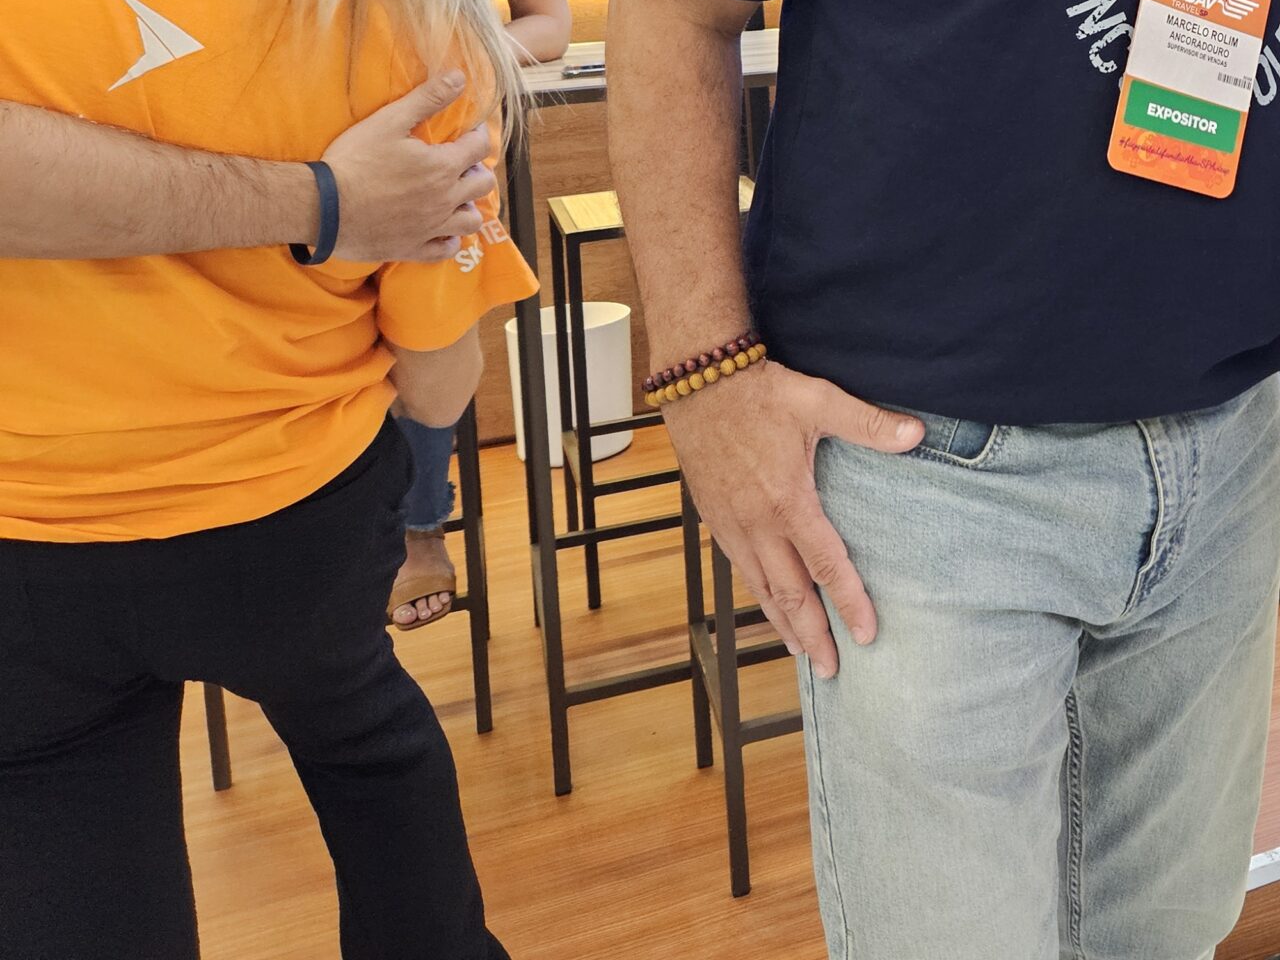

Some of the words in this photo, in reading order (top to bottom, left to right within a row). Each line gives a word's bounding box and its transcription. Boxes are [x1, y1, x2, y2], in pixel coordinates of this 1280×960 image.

[1166, 14, 1209, 37] MARCELO
[1210, 29, 1239, 47] ROLIM
[1169, 31, 1230, 58] ANCORADOURO
[1167, 42, 1199, 58] SUPERVISOR
[1207, 54, 1228, 68] VENDAS
[1146, 103, 1218, 135] EXPOSITOR
